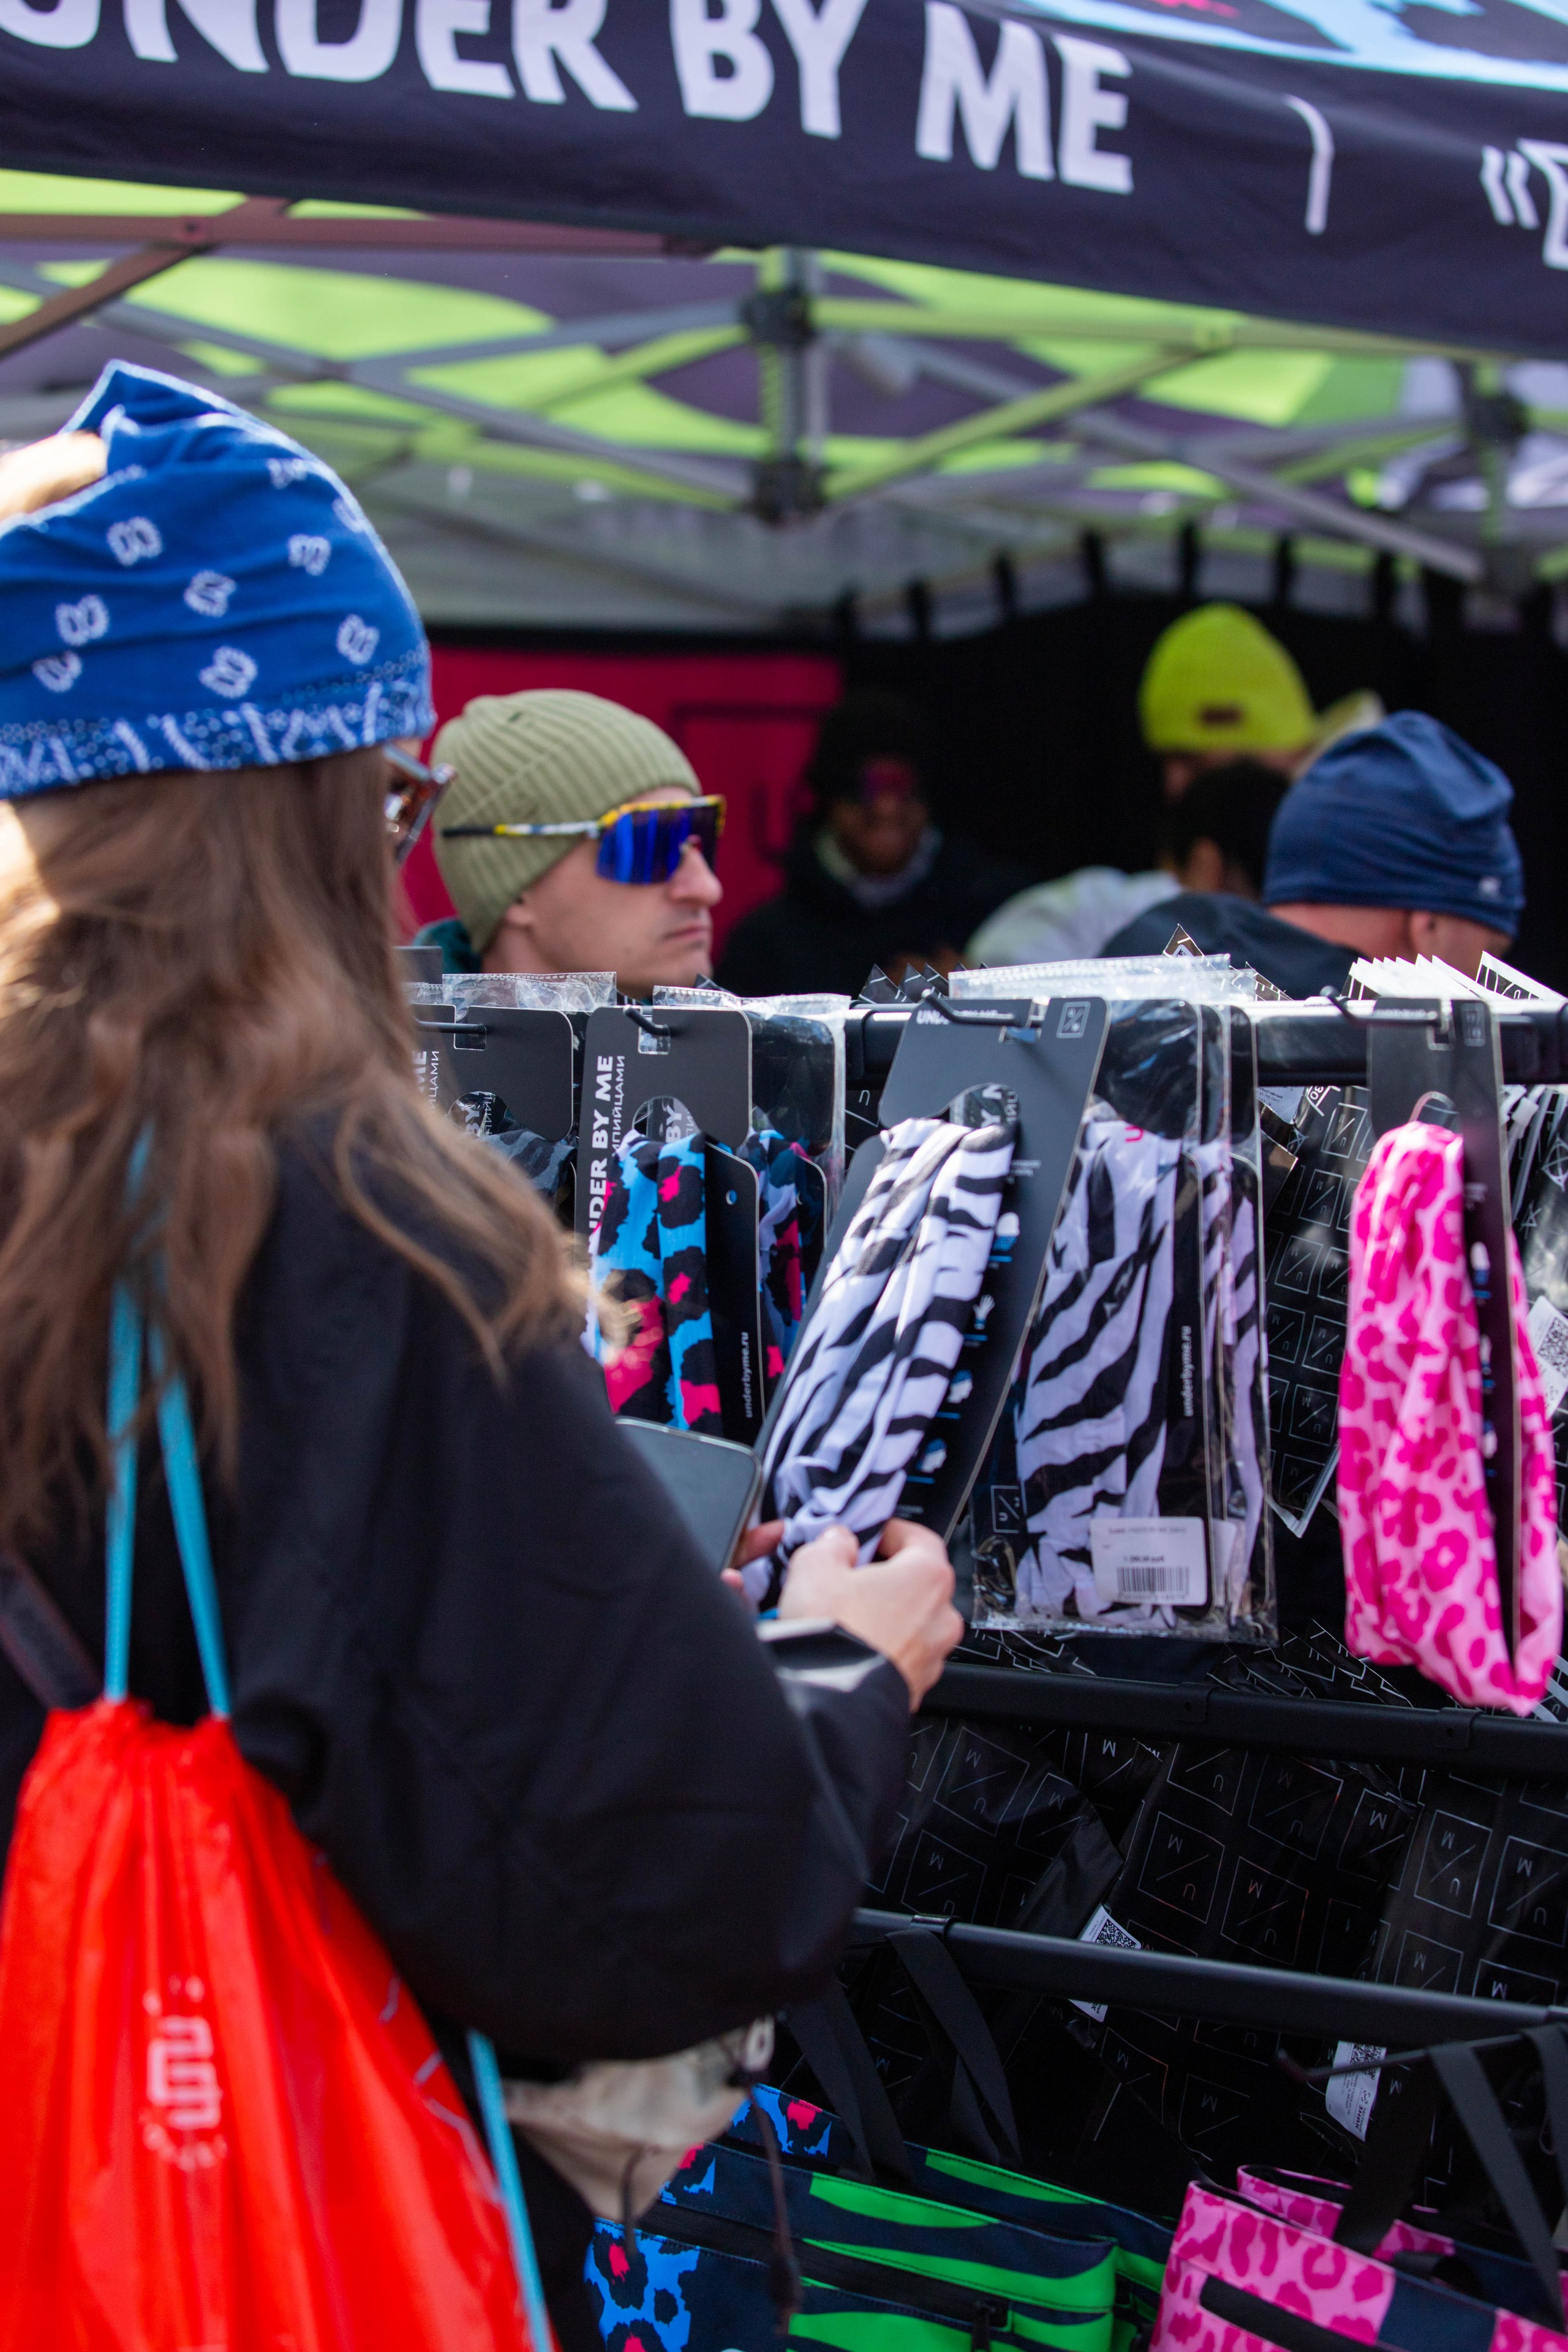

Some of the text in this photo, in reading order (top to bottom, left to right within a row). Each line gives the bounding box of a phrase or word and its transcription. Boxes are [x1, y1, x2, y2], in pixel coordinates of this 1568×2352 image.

[670, 0, 865, 139] BY
[915, 1, 1134, 194] ME
[595, 1056, 613, 1102] ME
[592, 1109, 609, 1149] BY
[741, 1332, 753, 1419] underbyme.ru
